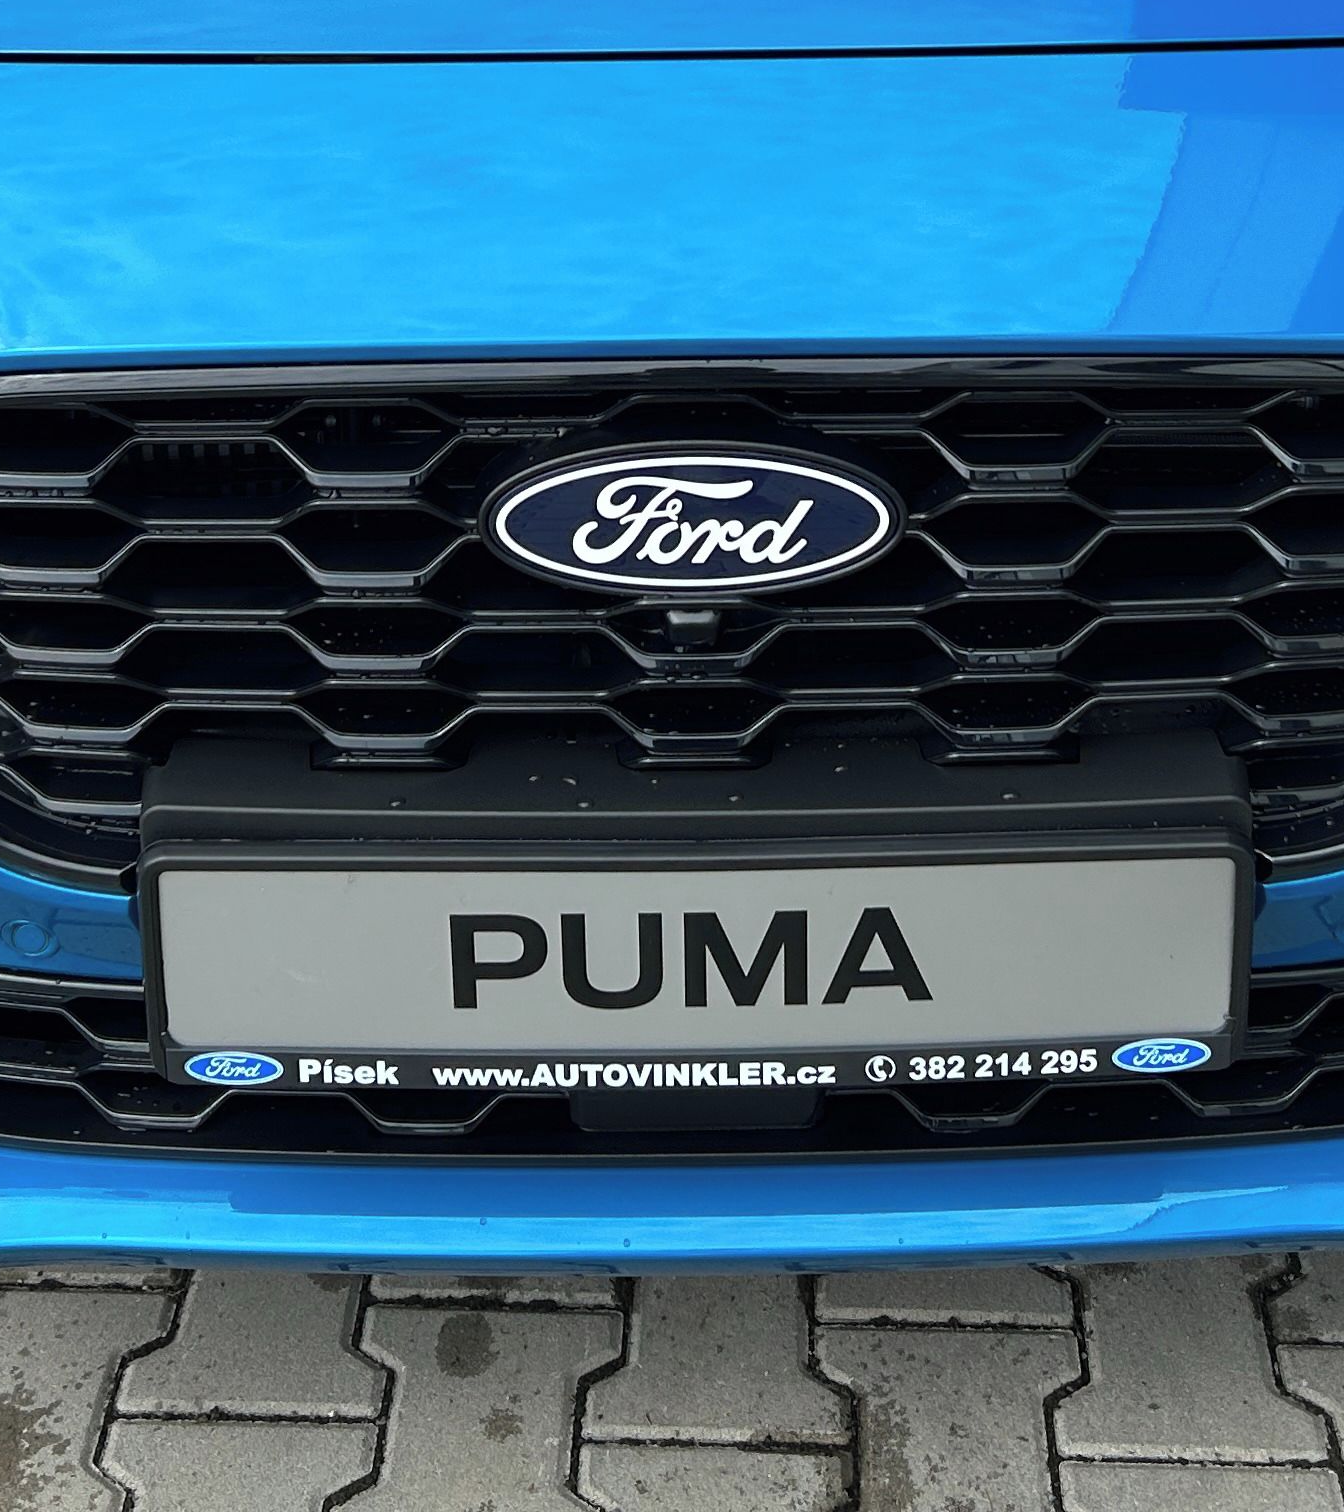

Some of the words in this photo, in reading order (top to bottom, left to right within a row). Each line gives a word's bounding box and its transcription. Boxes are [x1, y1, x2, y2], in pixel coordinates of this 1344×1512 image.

[571, 475, 814, 565] Ford
[449, 906, 934, 1010] PUMA
[205, 1055, 260, 1079] Ford
[297, 1058, 400, 1086] Písek
[431, 1062, 837, 1087] www.AUTOVINKLER.cz
[908, 1056, 966, 1081] 382
[974, 1052, 1032, 1078] 214
[1040, 1048, 1098, 1075] 295
[1132, 1044, 1190, 1067] Ford
